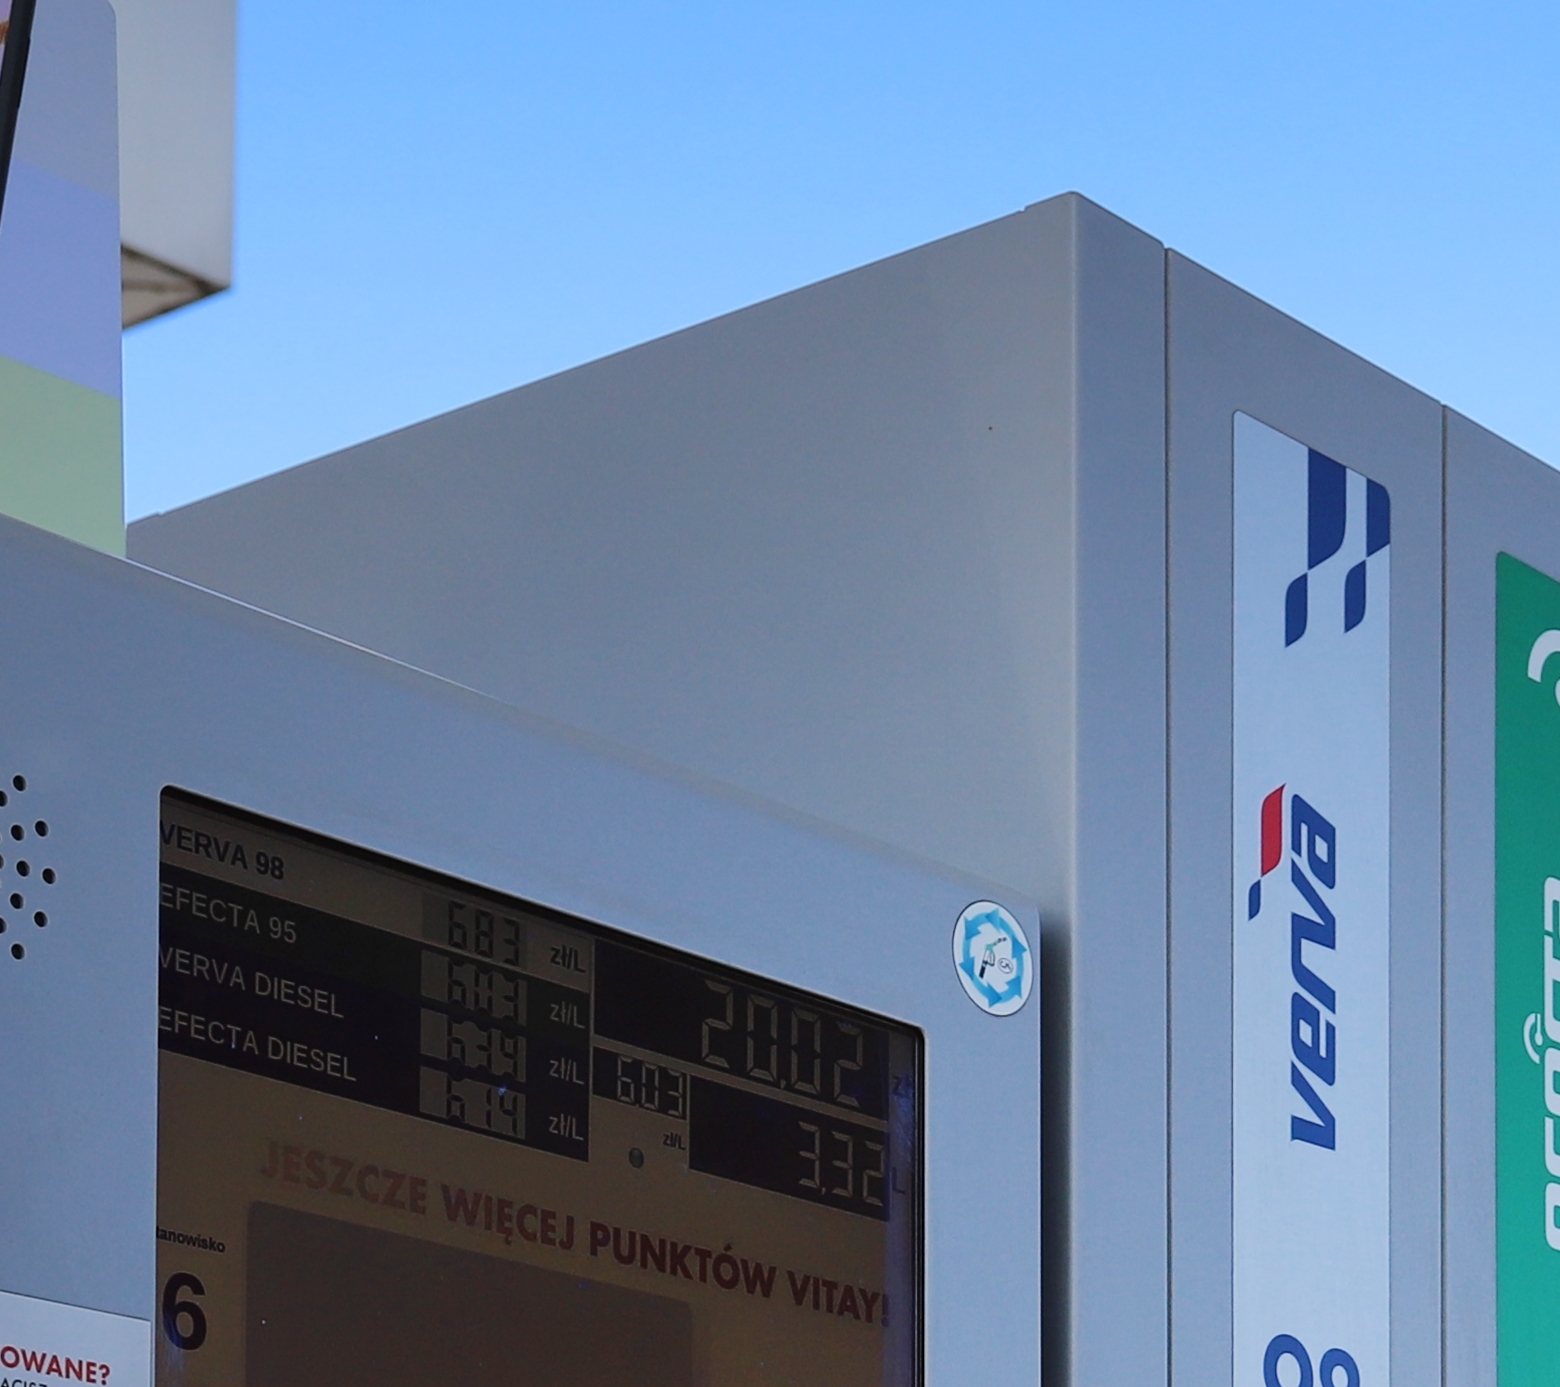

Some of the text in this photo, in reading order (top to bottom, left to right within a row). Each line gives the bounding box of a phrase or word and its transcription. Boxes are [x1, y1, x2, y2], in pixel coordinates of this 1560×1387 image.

[160, 820, 285, 880] VERVA 98
[160, 881, 297, 944] EFECTA 95
[160, 944, 345, 1019] VERVA DIESEL
[550, 945, 587, 974] zł/L
[1290, 793, 1337, 1152] verva
[159, 1005, 358, 1082] EFECTA DIESEL
[261, 1140, 891, 1328] JESZCZE WIĘCEJ PUNKTÓW VITAY!
[162, 1271, 208, 1351] 6
